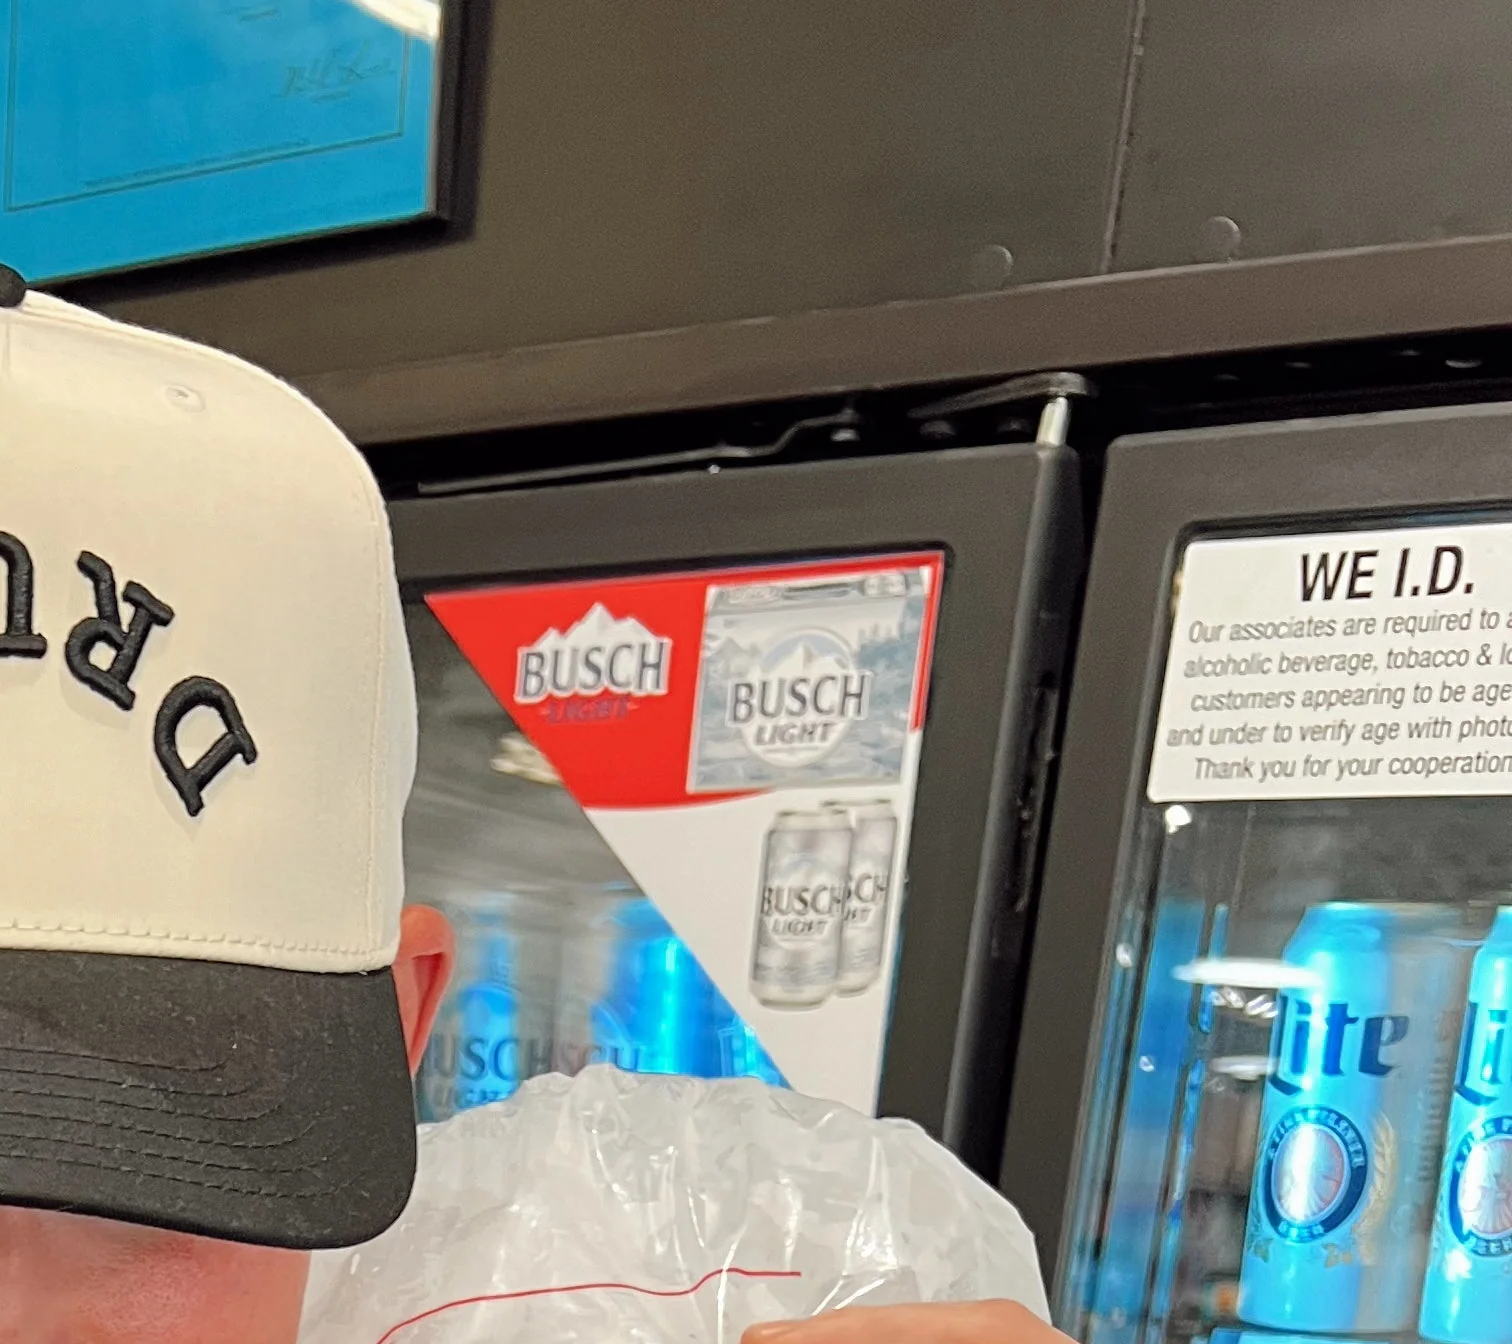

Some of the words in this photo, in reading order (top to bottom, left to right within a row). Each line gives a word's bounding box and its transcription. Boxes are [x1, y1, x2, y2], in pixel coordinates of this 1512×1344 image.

[1300, 550, 1379, 601] WE
[1393, 546, 1475, 597] I.D.
[1189, 620, 1225, 643] Our
[1229, 615, 1337, 641] associates
[1342, 617, 1377, 636] are
[1383, 608, 1473, 637] required
[1480, 608, 1500, 629] to
[520, 641, 667, 699] BUSCH
[1184, 652, 1273, 678] alcoholic
[1278, 651, 1378, 676] beverage,
[1386, 646, 1470, 670] tobacco
[1476, 643, 1493, 666] &
[732, 674, 870, 723] BUSCH
[1191, 690, 1296, 713] customers
[1301, 682, 1406, 712] appearing
[1413, 682, 1433, 704] to
[1439, 680, 1466, 703] be
[754, 721, 836, 746] LIGHT
[1166, 723, 1204, 747] and
[1209, 722, 1268, 745] under
[1273, 721, 1293, 743] to
[1299, 719, 1356, 746] verify
[1361, 721, 1400, 746] age
[1407, 716, 1452, 739] with
[1194, 755, 1255, 780] Thank
[1258, 759, 1297, 784] you
[1302, 754, 1333, 778] for
[1335, 757, 1384, 782] your
[434, 1036, 554, 1082] USCH
